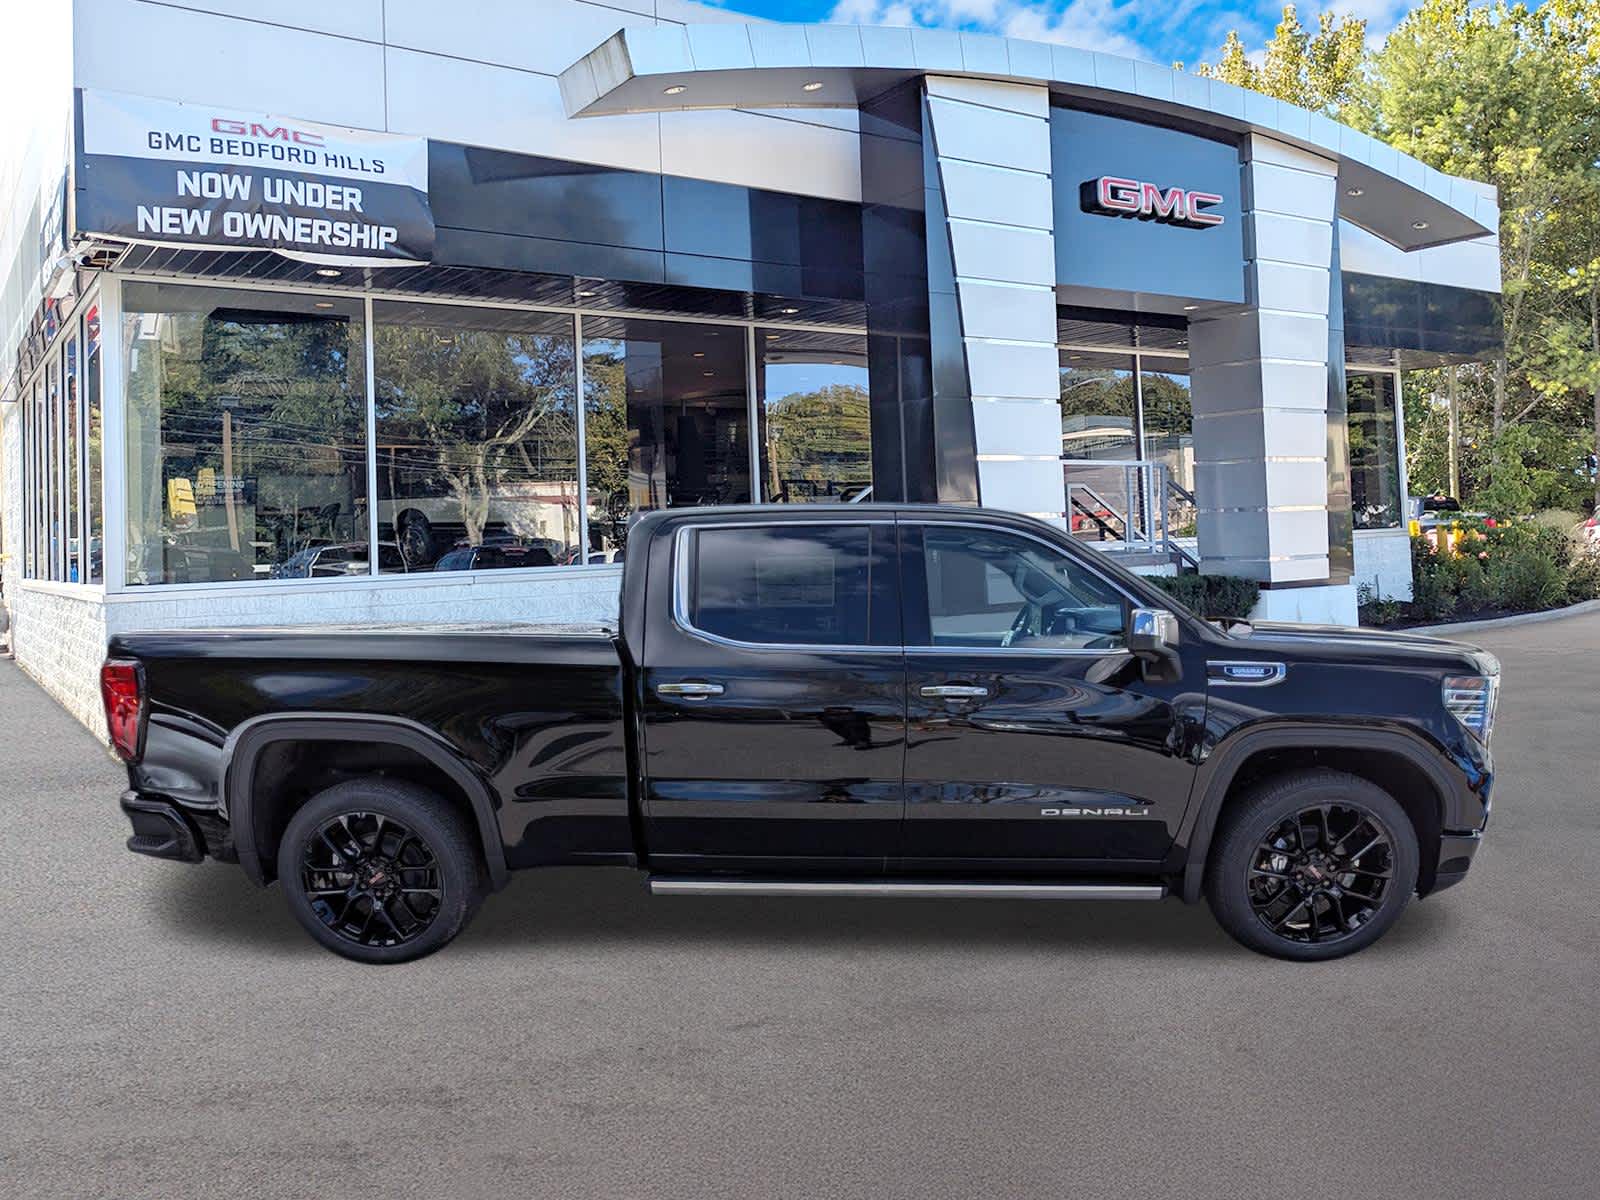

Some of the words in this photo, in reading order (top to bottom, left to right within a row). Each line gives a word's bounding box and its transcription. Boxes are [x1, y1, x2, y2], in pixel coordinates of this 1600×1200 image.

[148, 131, 201, 152] GMC
[210, 137, 317, 165] BEDFORD
[324, 152, 385, 174] HILLS
[211, 118, 326, 148] GMC
[176, 170, 253, 201] NOW
[263, 176, 363, 213] UNDER
[1097, 175, 1225, 225] GMC
[136, 205, 212, 236] NEW
[223, 211, 398, 250] OWNERSHIP
[1041, 808, 1149, 816] DENALI
